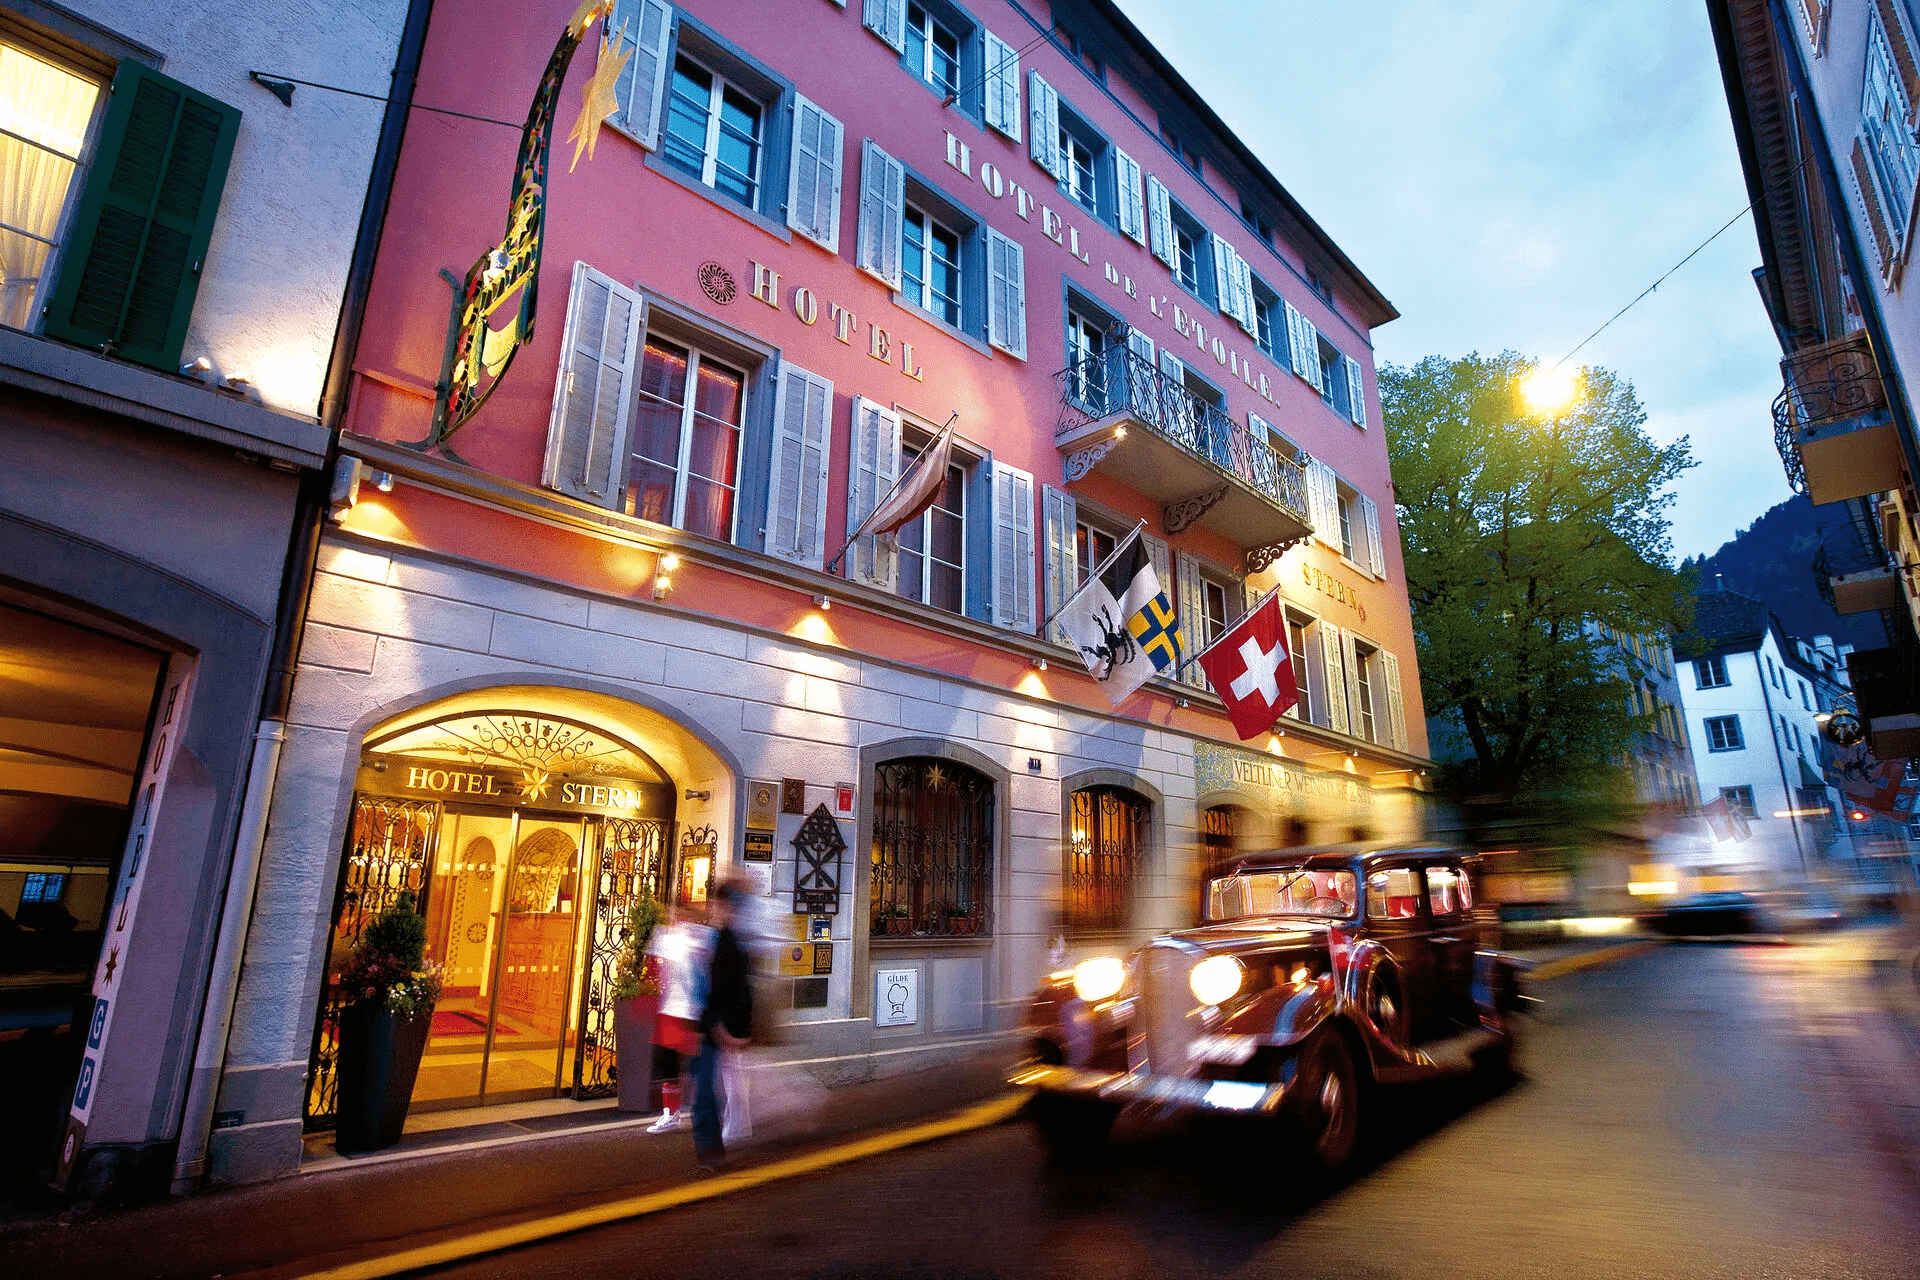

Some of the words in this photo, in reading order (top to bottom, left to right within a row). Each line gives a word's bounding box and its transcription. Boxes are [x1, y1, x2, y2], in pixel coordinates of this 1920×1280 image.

[943, 129, 1090, 266] HOTEL
[1104, 262, 1137, 300] DE
[747, 258, 924, 382] HOTEL
[1303, 562, 1357, 610] STERN
[406, 767, 501, 796] HOTEL
[561, 782, 643, 810] STERN
[1233, 759, 1292, 790] VELTLINER
[115, 683, 180, 933] HOTEL
[79, 1065, 91, 1098] P
